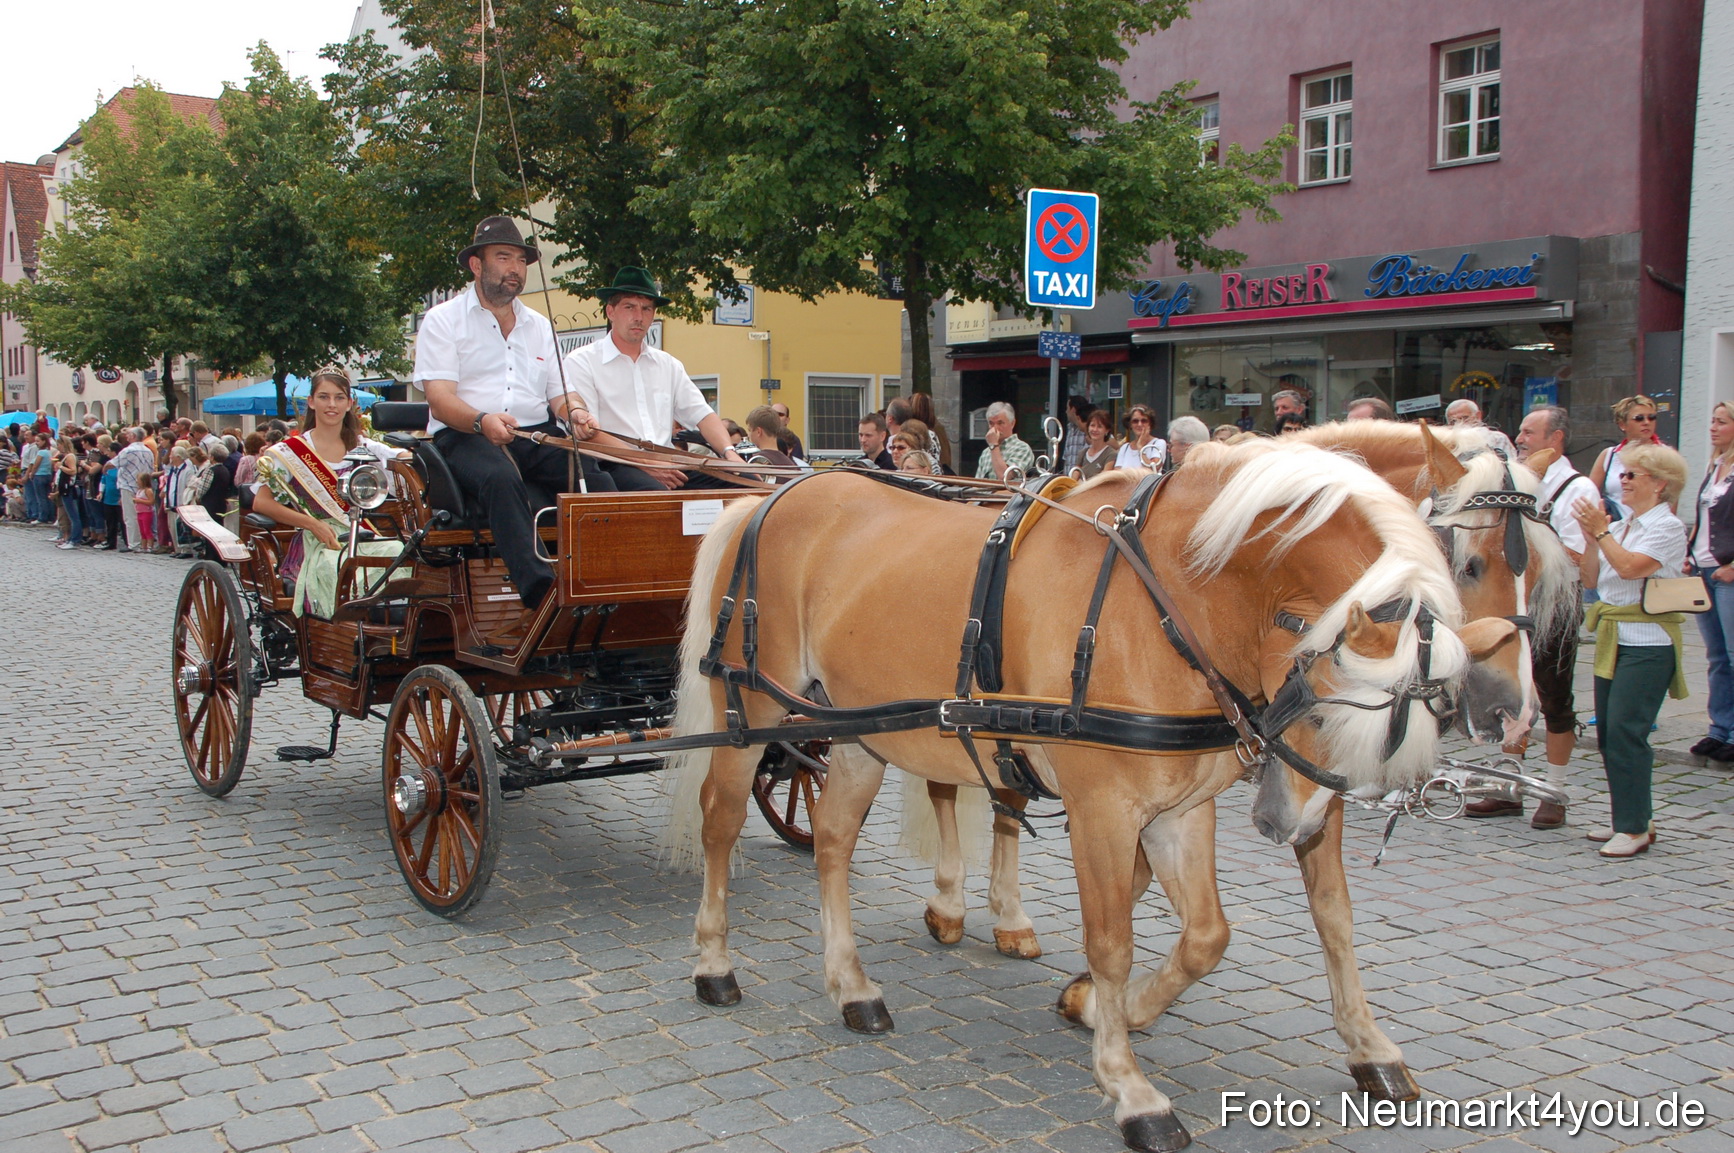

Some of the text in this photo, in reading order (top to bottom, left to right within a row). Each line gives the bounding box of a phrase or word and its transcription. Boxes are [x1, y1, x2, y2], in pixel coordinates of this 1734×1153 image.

[1033, 271, 1088, 298] TAXI
[1128, 252, 1539, 327] Café REISER Bäckerei
